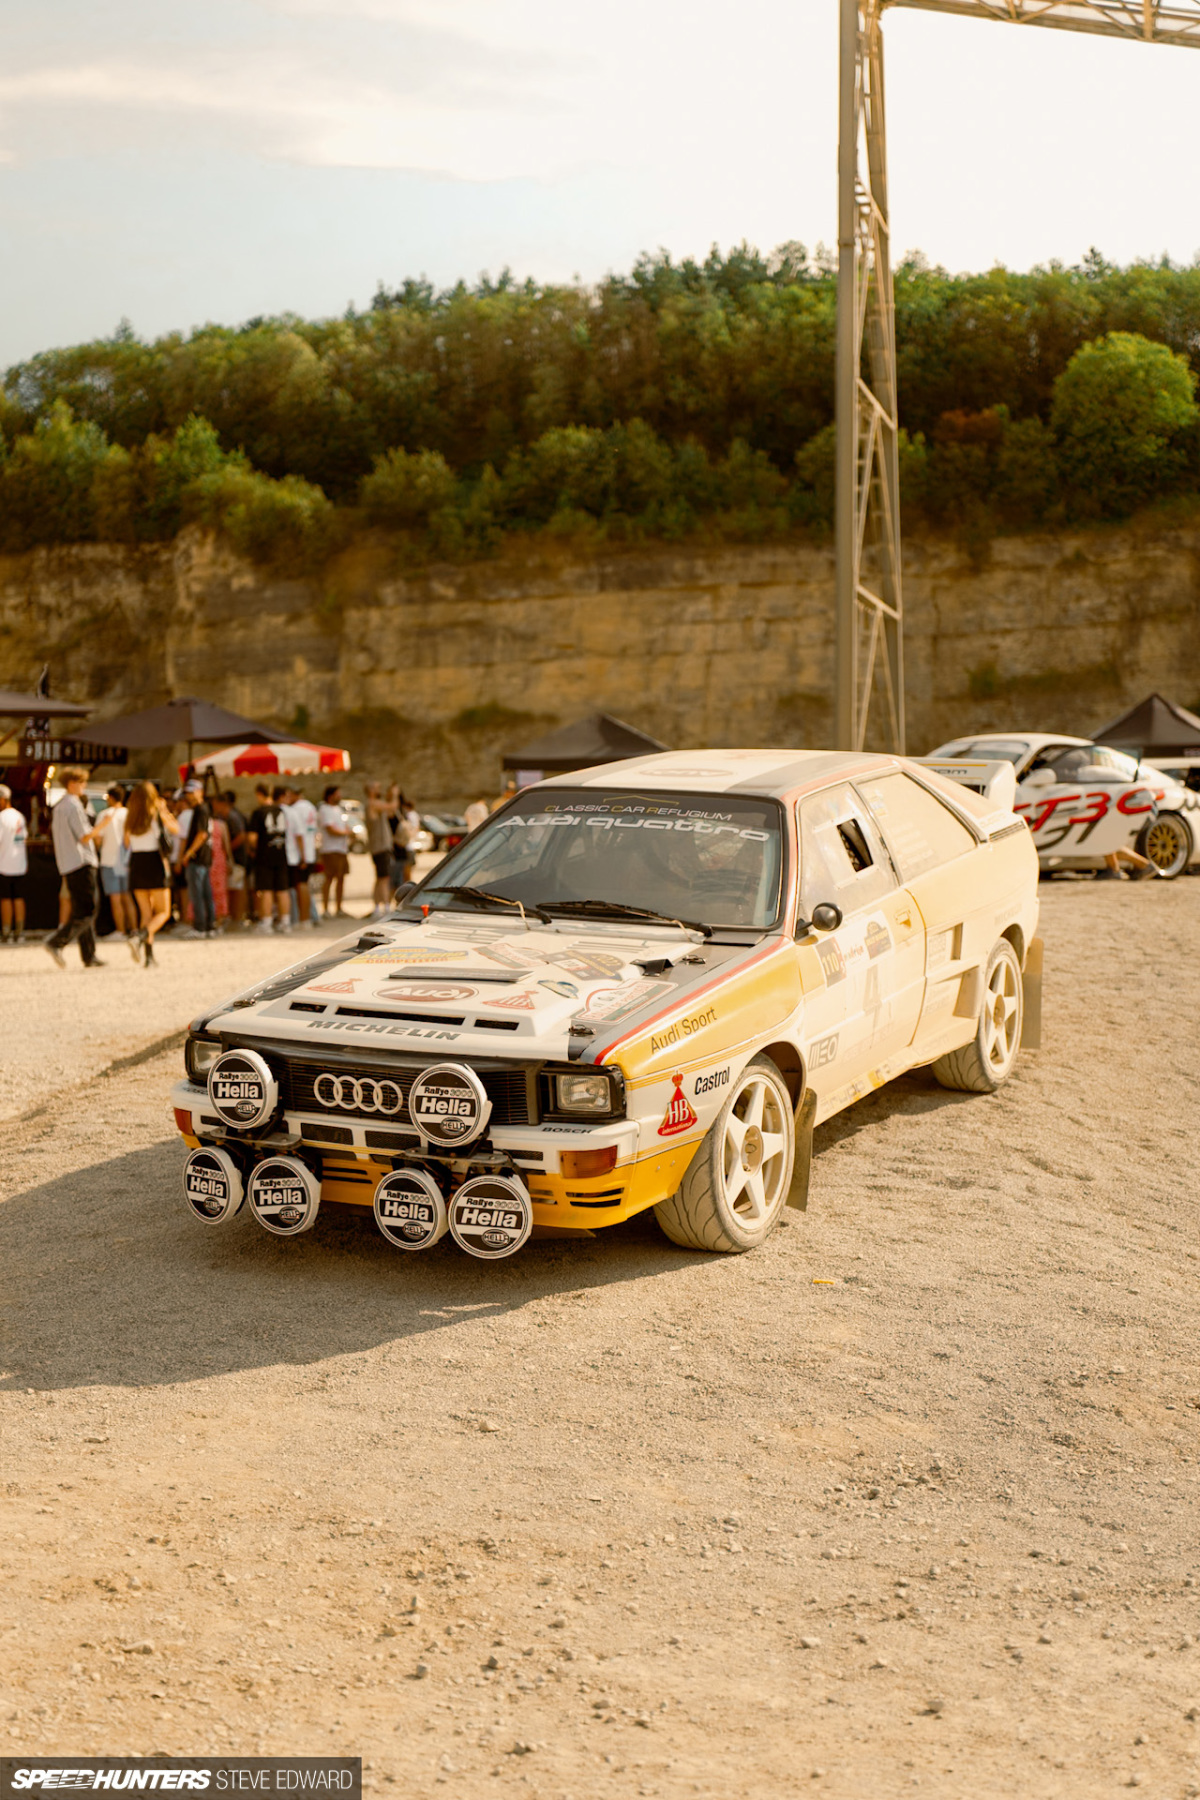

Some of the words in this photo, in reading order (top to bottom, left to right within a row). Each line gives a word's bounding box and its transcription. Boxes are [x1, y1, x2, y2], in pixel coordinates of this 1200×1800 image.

[544, 804, 610, 813] CLASSIC
[611, 805, 645, 814] CAR
[646, 806, 733, 821] REFUGIUM
[496, 814, 580, 829] Audi
[585, 816, 770, 842] quattro
[307, 1020, 461, 1041] MICHELIN
[651, 1023, 681, 1055] Audi
[682, 1006, 718, 1036] Sport
[218, 1072, 240, 1081] Rallye
[240, 1072, 259, 1081] 3000
[695, 1066, 730, 1095] Castrol
[217, 1082, 259, 1098] Hella
[423, 1086, 450, 1096] Rallye
[450, 1088, 473, 1098] 3000
[237, 1104, 256, 1112] HELLA
[420, 1097, 472, 1116] Hella
[667, 1098, 690, 1125] HB
[442, 1121, 466, 1132] HELLA
[542, 1127, 592, 1135] BOSCH
[192, 1166, 209, 1177] Rallye
[209, 1170, 225, 1181] 3000
[190, 1176, 224, 1197] Hella
[259, 1180, 281, 1188] Rallye
[282, 1178, 301, 1187] 3000
[259, 1188, 302, 1205] Hella
[386, 1190, 409, 1201] Rallye
[409, 1194, 430, 1204] 3000
[466, 1197, 494, 1207] Rallye
[494, 1200, 521, 1210] 3000
[384, 1201, 429, 1221] Hella
[460, 1208, 518, 1228] Hella
[404, 1225, 425, 1237] HELLA
[484, 1234, 509, 1245] HELLA
